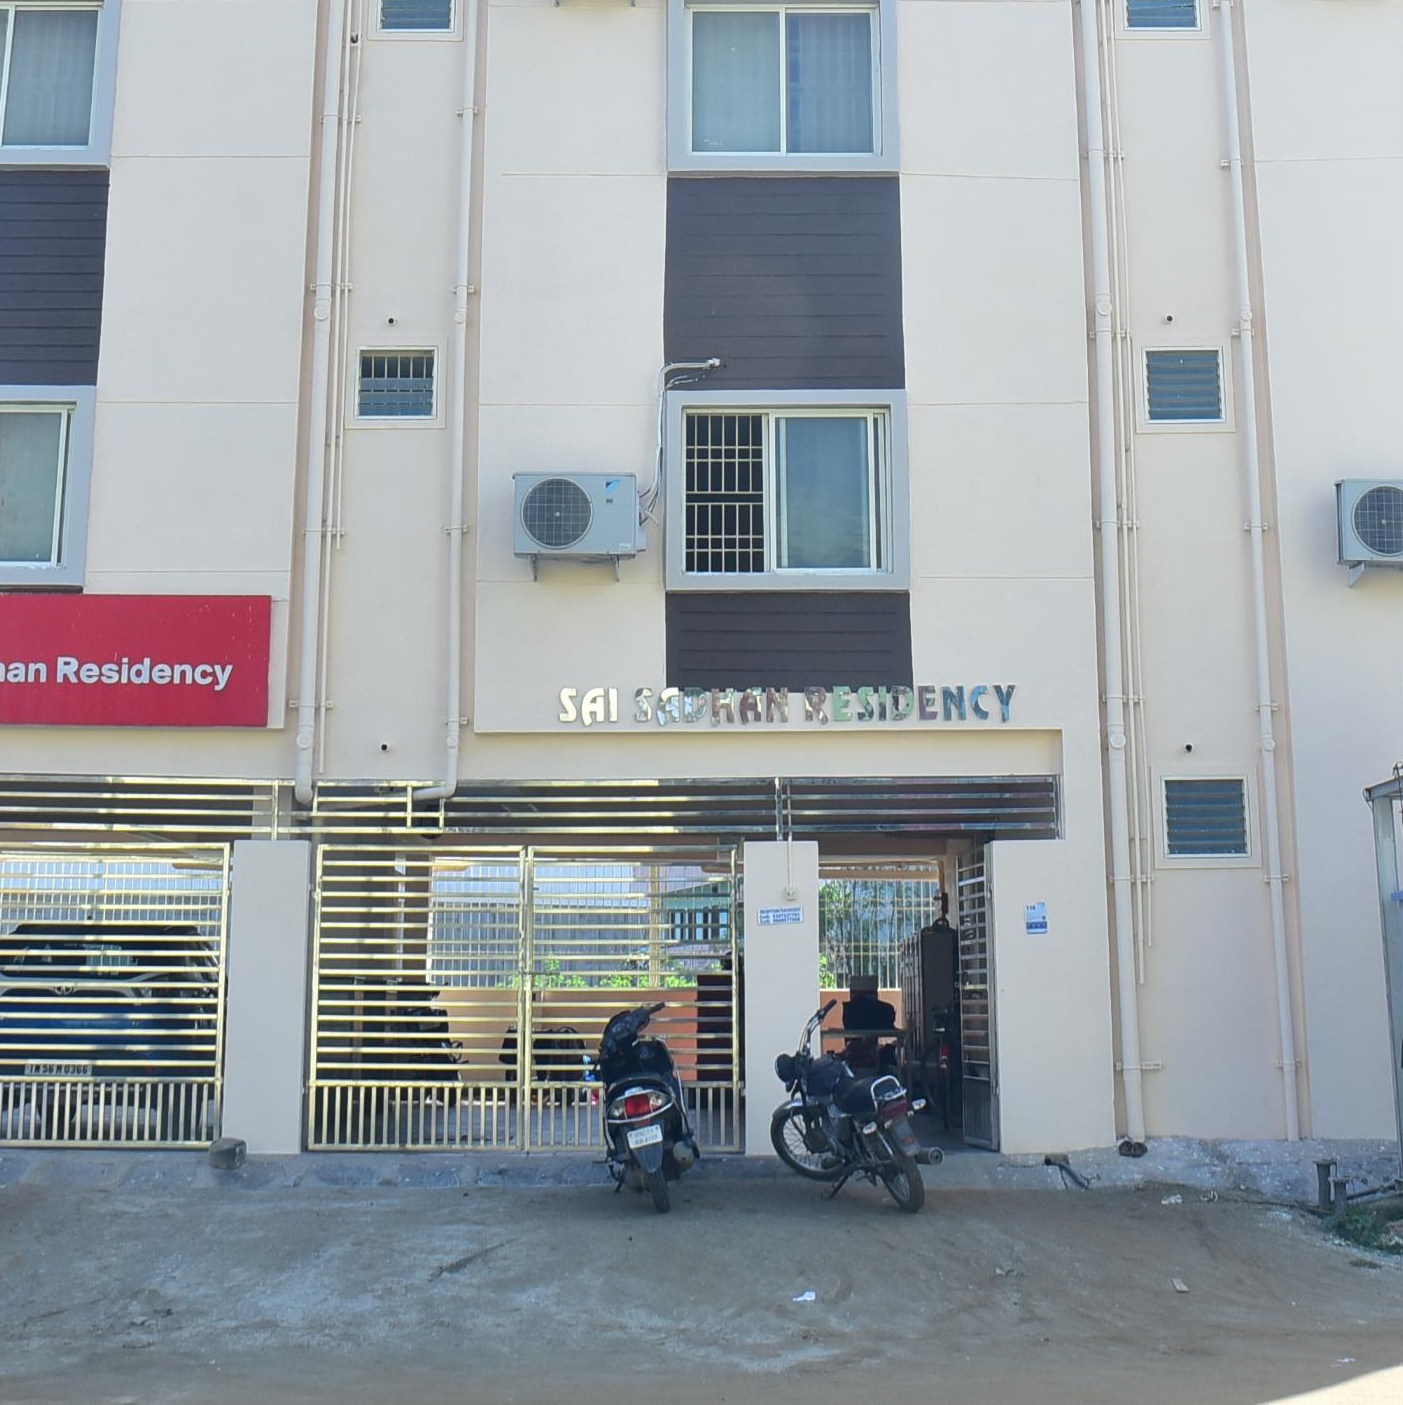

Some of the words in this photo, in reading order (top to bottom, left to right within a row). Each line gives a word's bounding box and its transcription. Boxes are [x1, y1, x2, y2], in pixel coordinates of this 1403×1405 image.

[55, 656, 233, 692] Residency
[559, 687, 618, 727] SAI
[635, 686, 789, 727] SADHAN
[803, 684, 1017, 726] RESIDENCY
